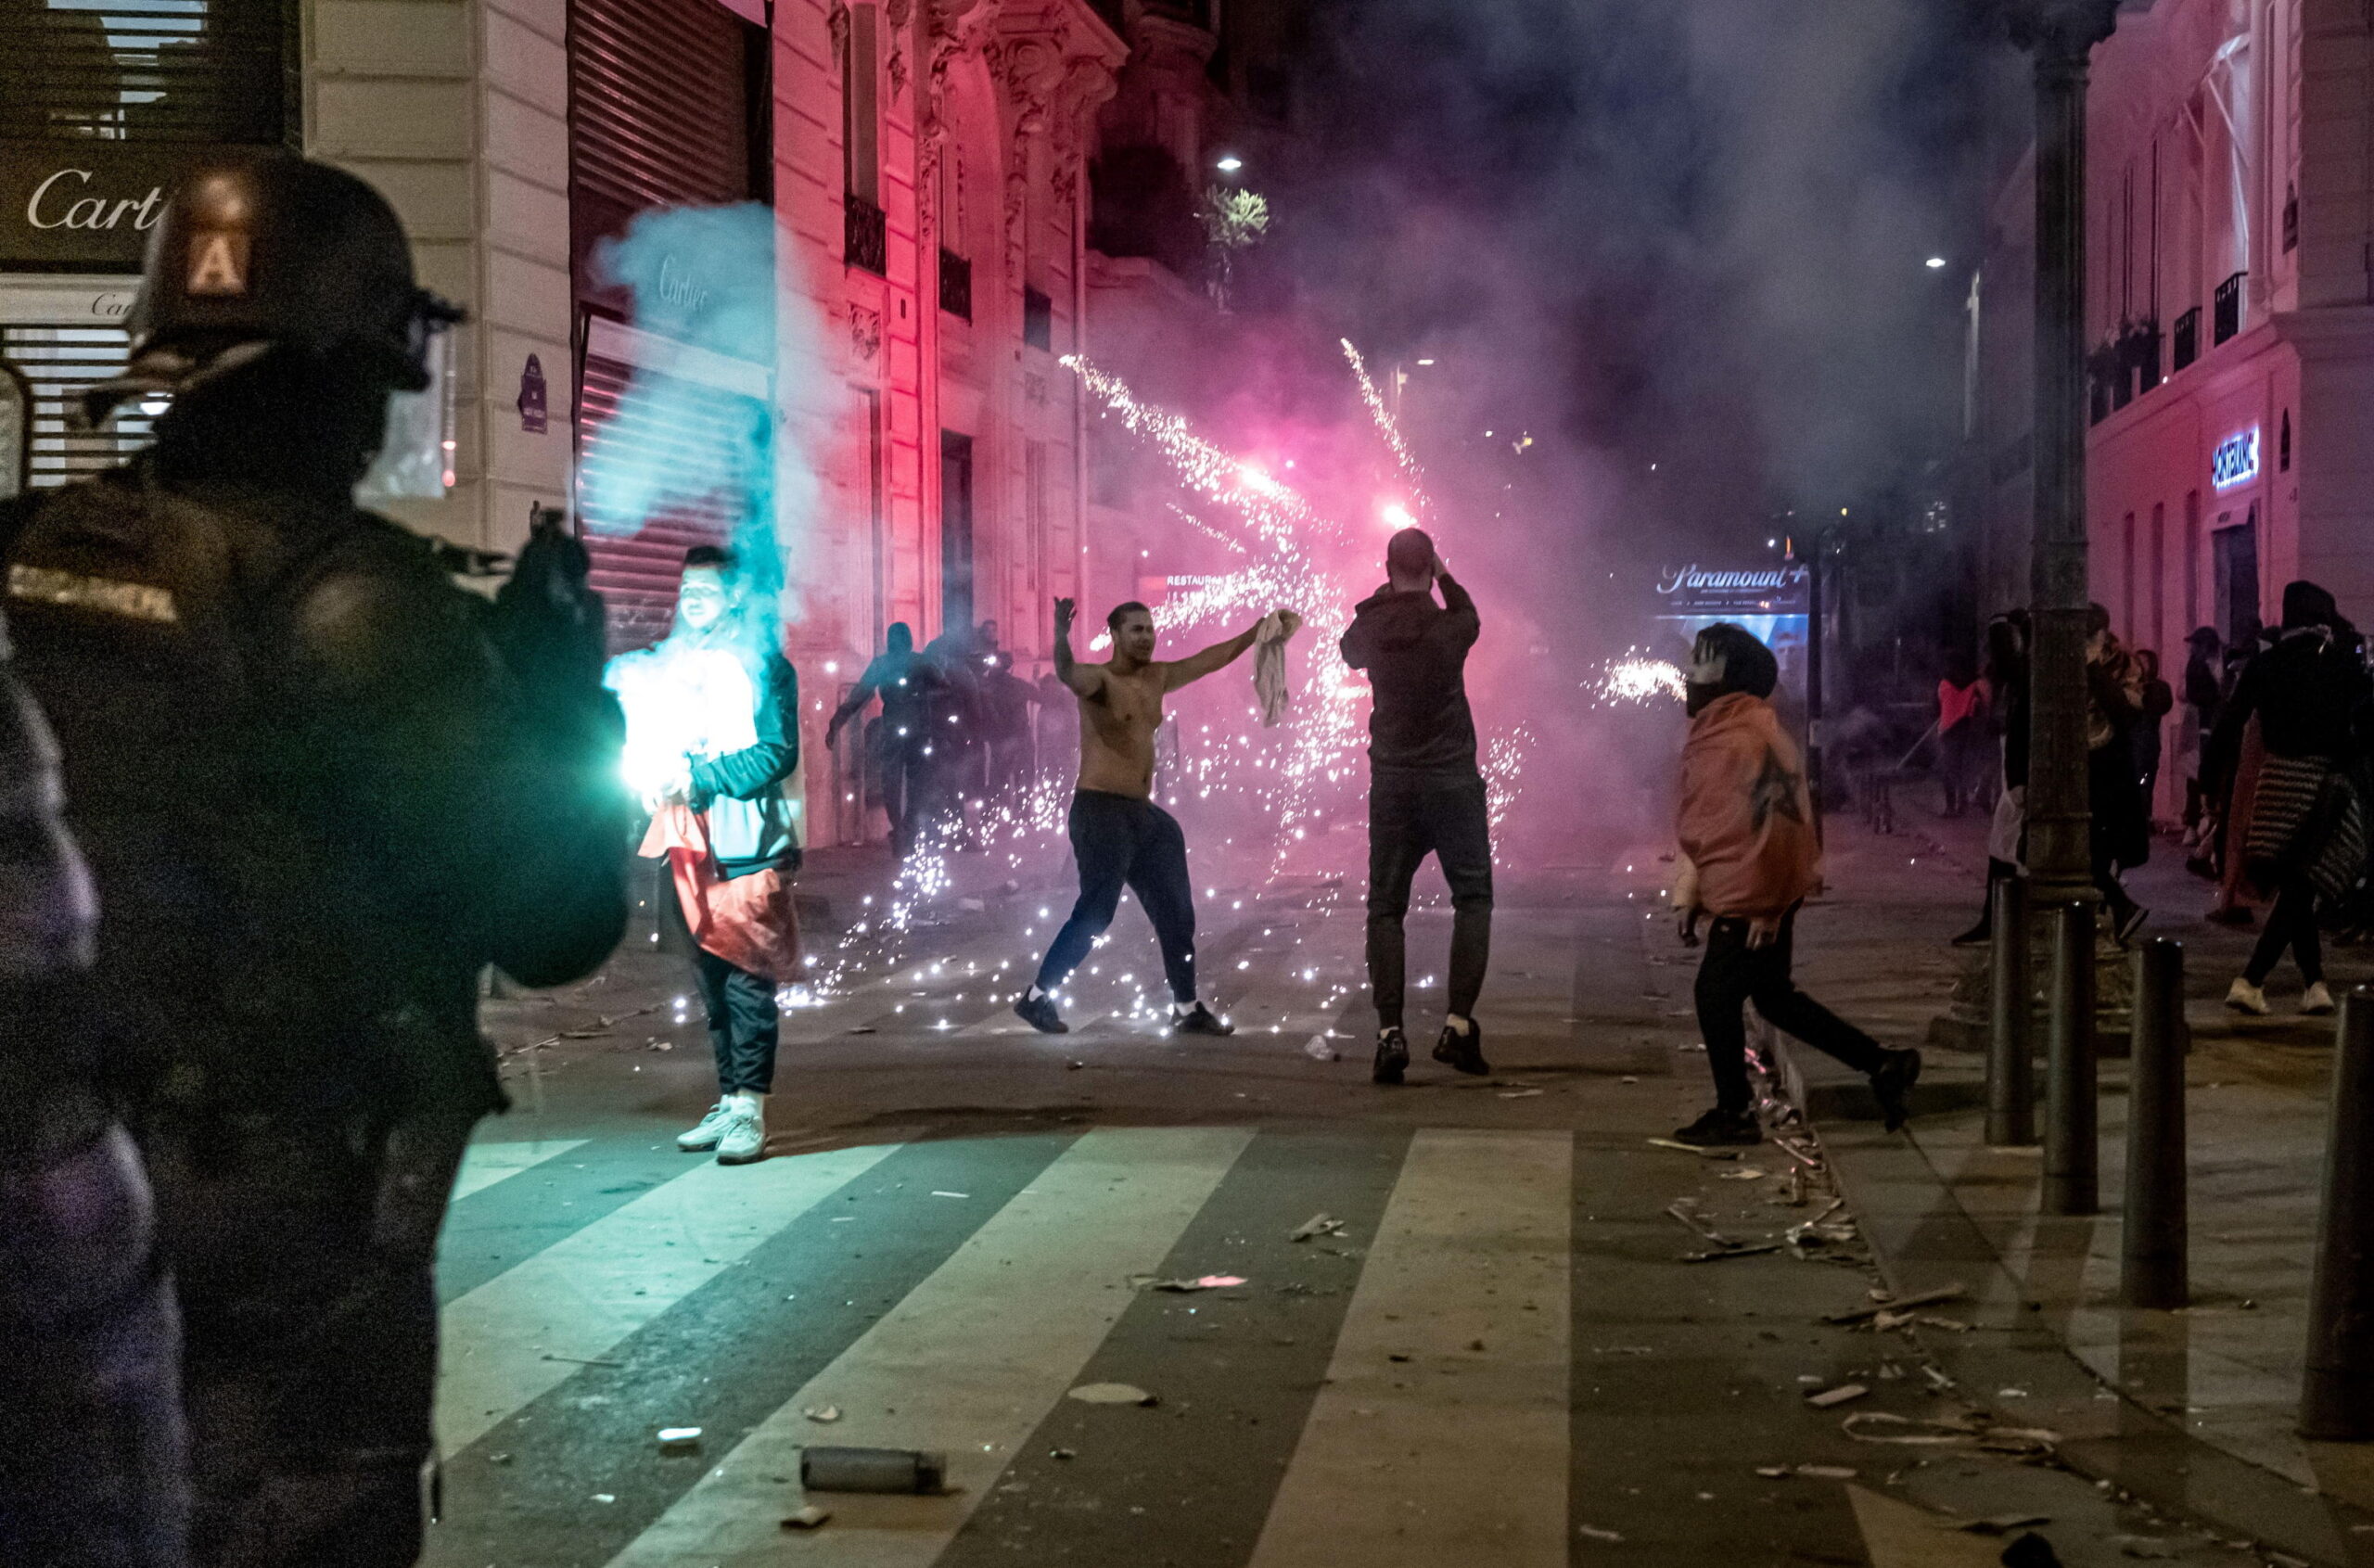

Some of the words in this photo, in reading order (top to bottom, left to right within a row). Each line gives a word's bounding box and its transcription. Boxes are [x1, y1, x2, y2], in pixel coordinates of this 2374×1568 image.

[28, 169, 171, 230] Cart
[189, 236, 244, 292] A
[659, 253, 708, 309] Cartier
